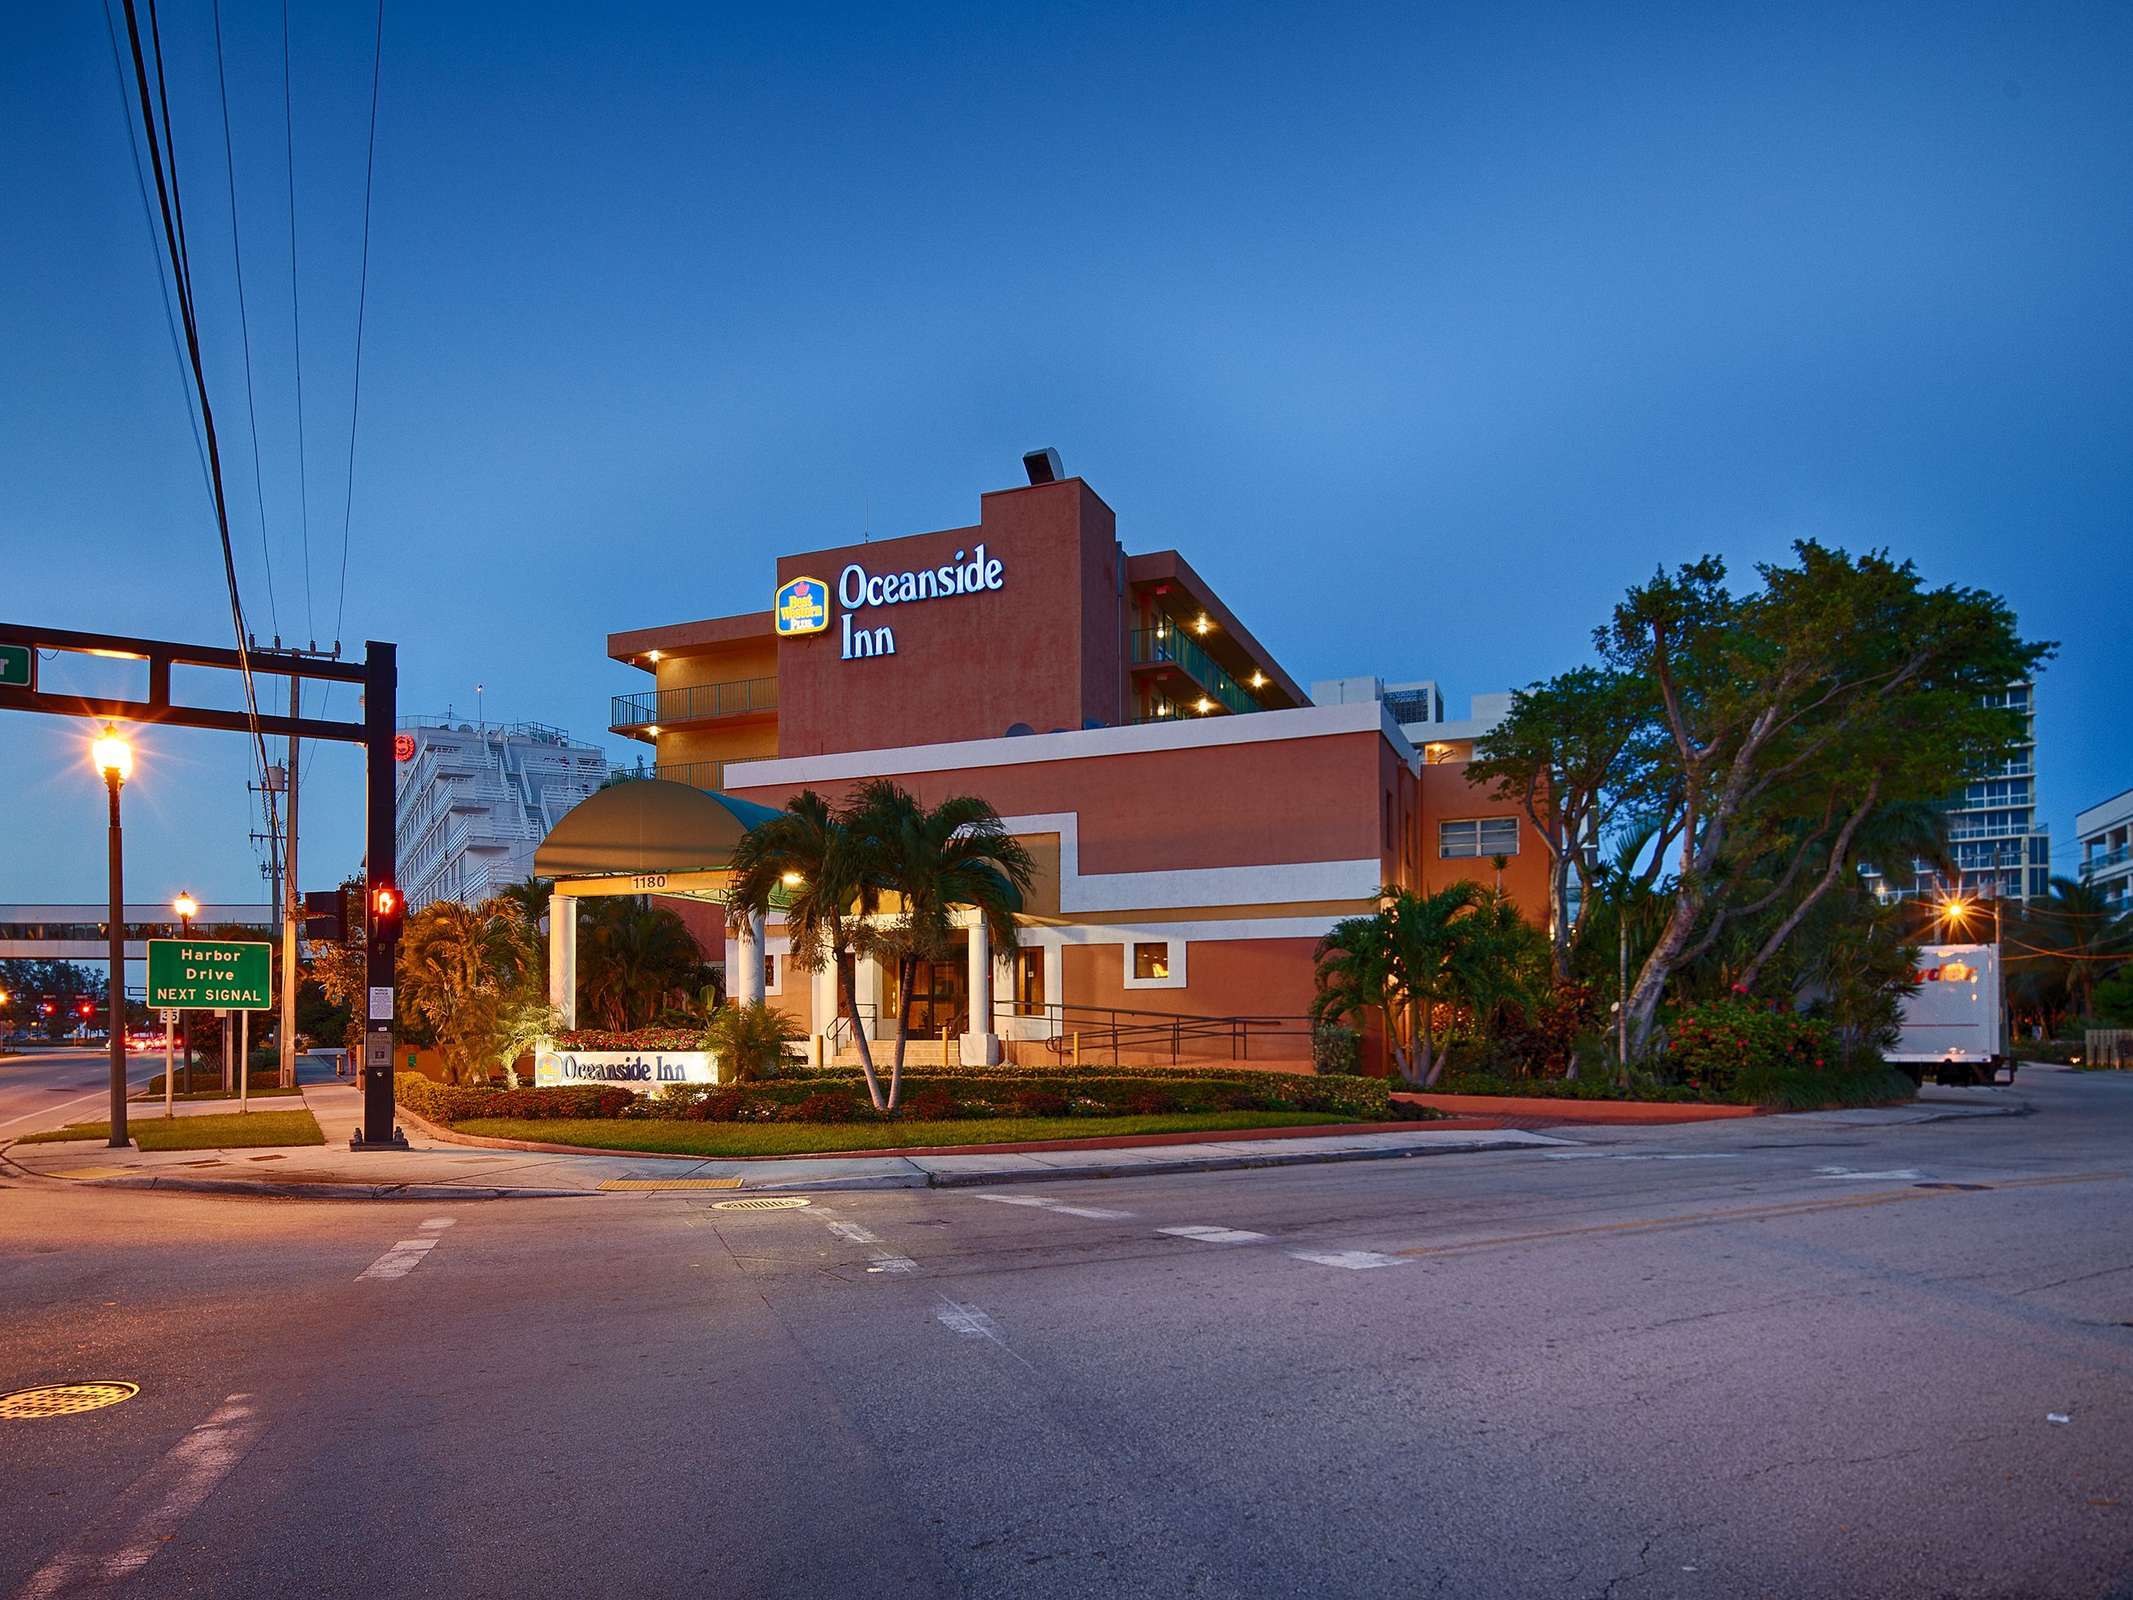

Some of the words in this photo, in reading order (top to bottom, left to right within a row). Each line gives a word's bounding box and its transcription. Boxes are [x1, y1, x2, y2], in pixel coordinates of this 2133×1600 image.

[838, 543, 1004, 610] Oceanside
[841, 613, 896, 660] Inn
[633, 875, 665, 889] 1180
[181, 948, 241, 962] Harbor
[186, 967, 235, 981] Drive
[157, 988, 197, 1001] NEXT
[205, 989, 262, 1002] SIGNAL
[564, 1055, 651, 1082] Oceanside
[656, 1055, 687, 1082] Inn
